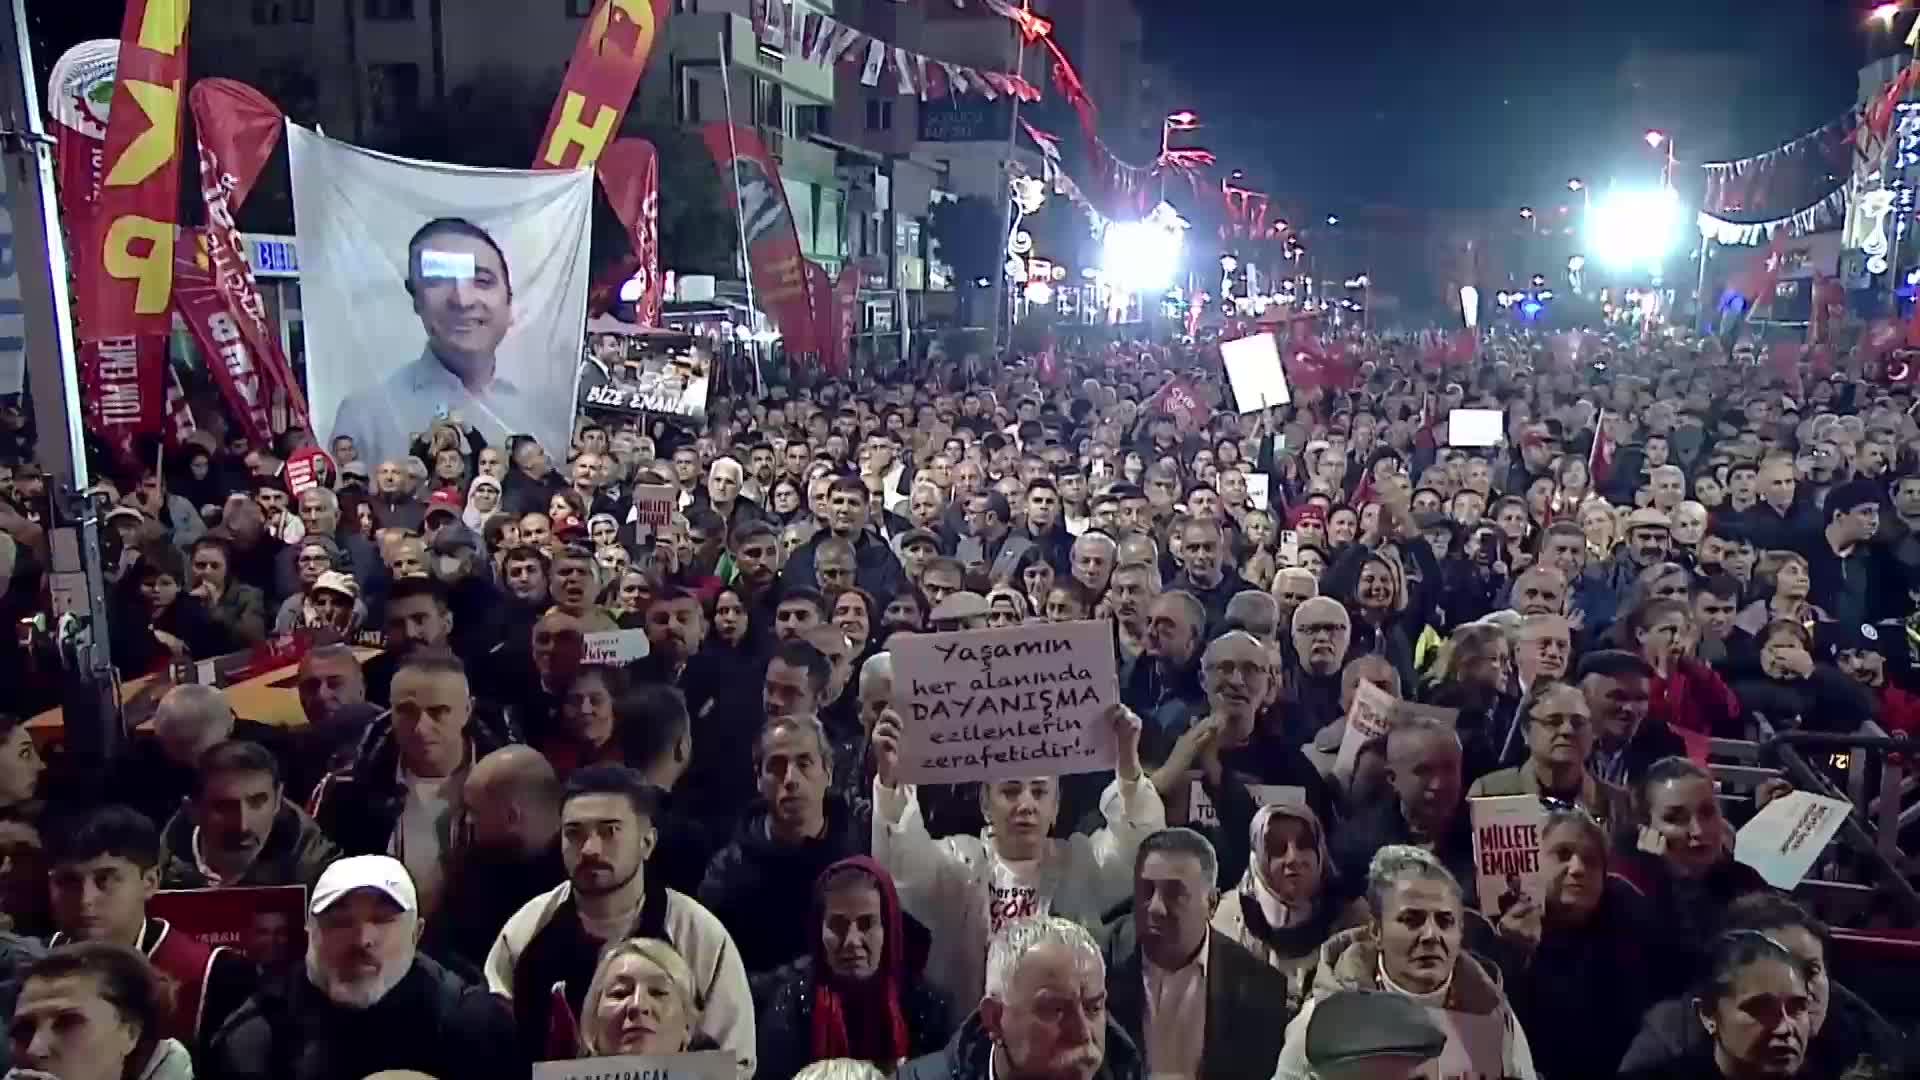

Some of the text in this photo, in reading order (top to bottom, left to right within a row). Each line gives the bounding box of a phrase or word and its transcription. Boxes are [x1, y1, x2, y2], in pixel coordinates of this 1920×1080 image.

[98, 335, 139, 381] EME
[932, 639, 1073, 671] Yaşamın
[912, 664, 1092, 697] her alanında
[910, 686, 1101, 721] DAYANIŞMA
[929, 718, 1082, 745] ezilenlerin
[1481, 849, 1540, 876] EMANET
